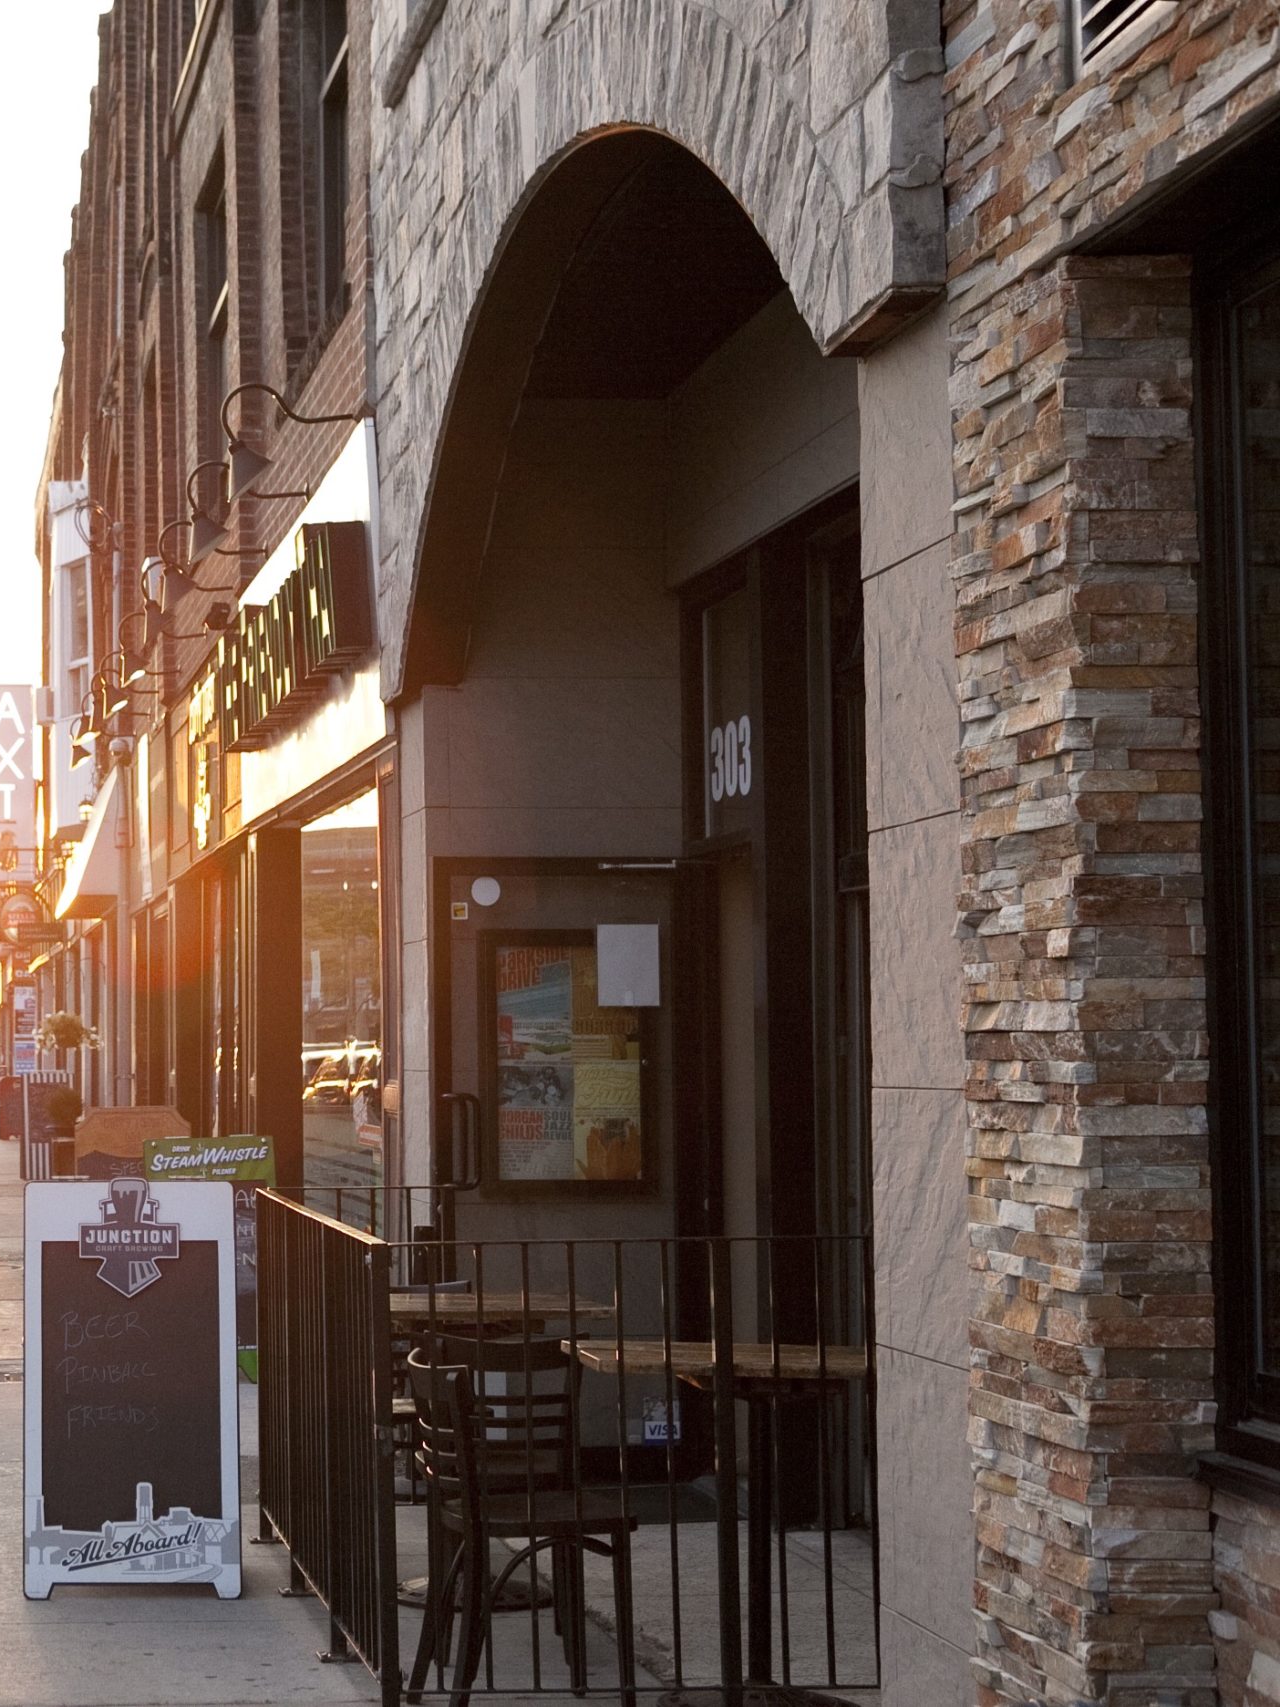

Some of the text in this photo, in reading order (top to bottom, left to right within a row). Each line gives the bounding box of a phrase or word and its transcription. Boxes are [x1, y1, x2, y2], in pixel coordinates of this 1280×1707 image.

[711, 714, 752, 802] 303
[85, 1229, 173, 1245] JUNCTION
[61, 1310, 151, 1352] BEER
[62, 1522, 202, 1567] All Aboard!
